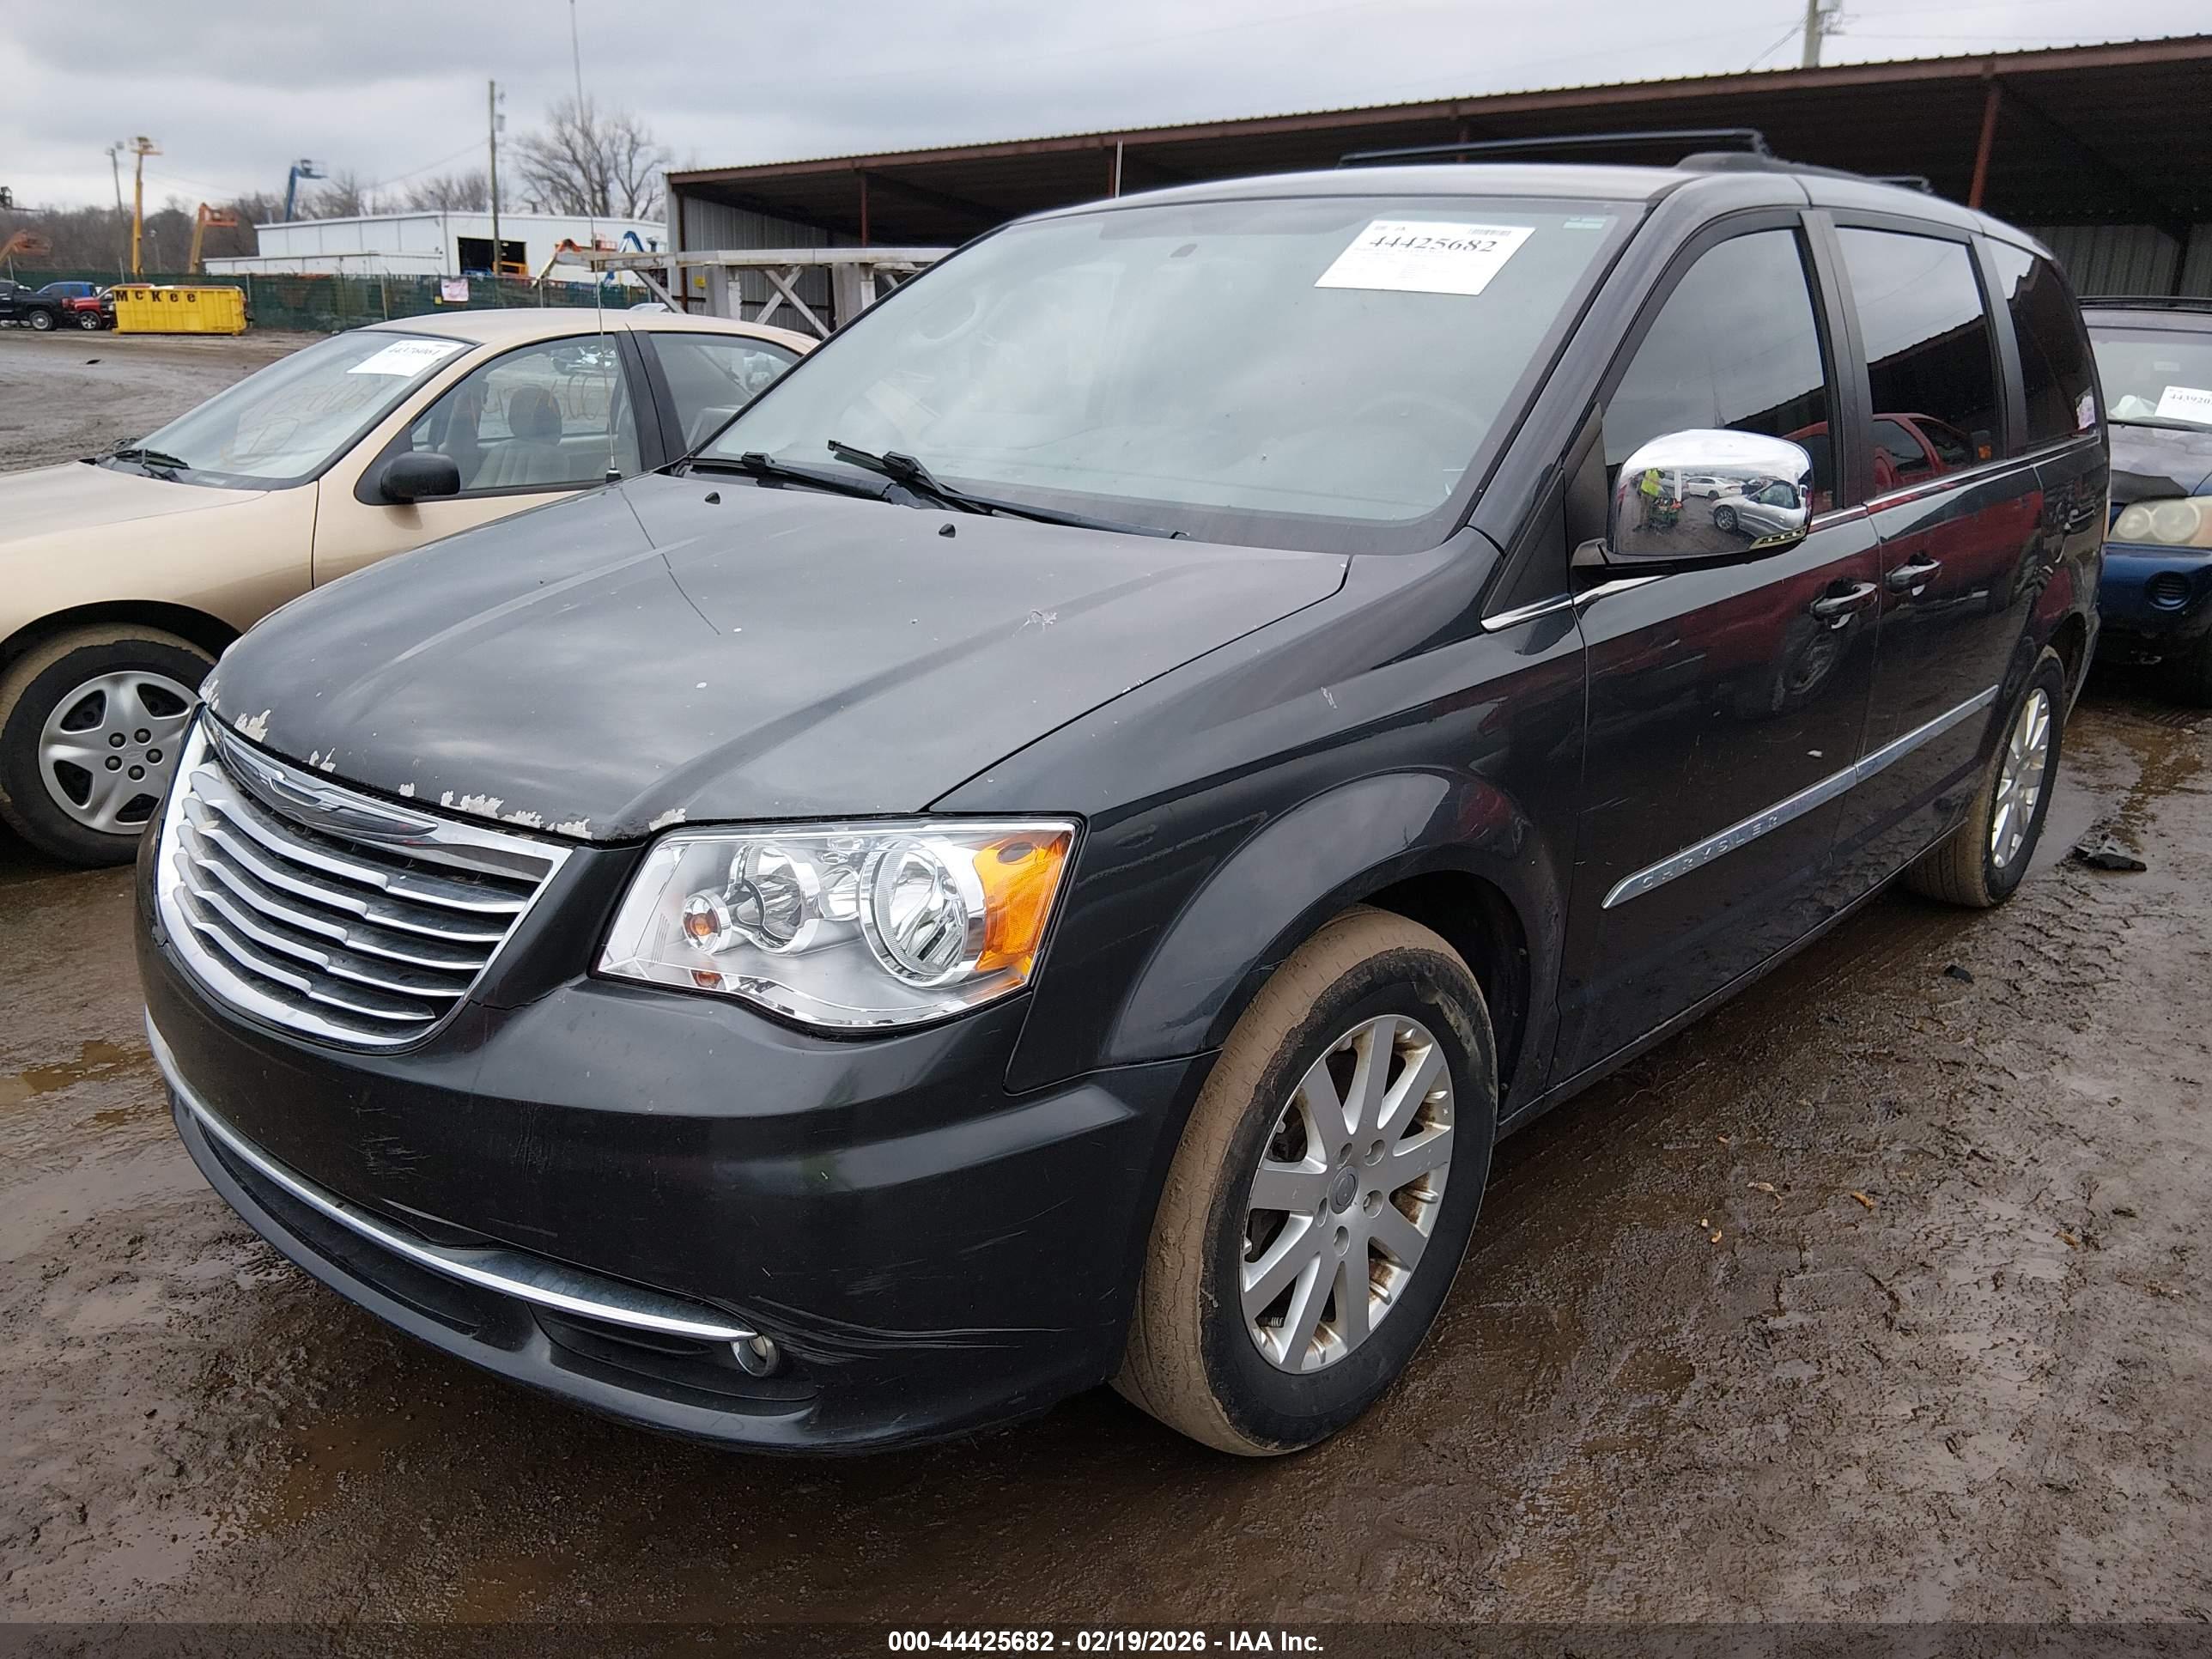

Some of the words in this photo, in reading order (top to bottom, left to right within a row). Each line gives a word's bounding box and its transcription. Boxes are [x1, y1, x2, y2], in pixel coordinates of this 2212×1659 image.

[1369, 235, 1498, 253] 44425682
[2169, 392, 2212, 405] 443920
[1641, 815, 1778, 890] CHRYSLER
